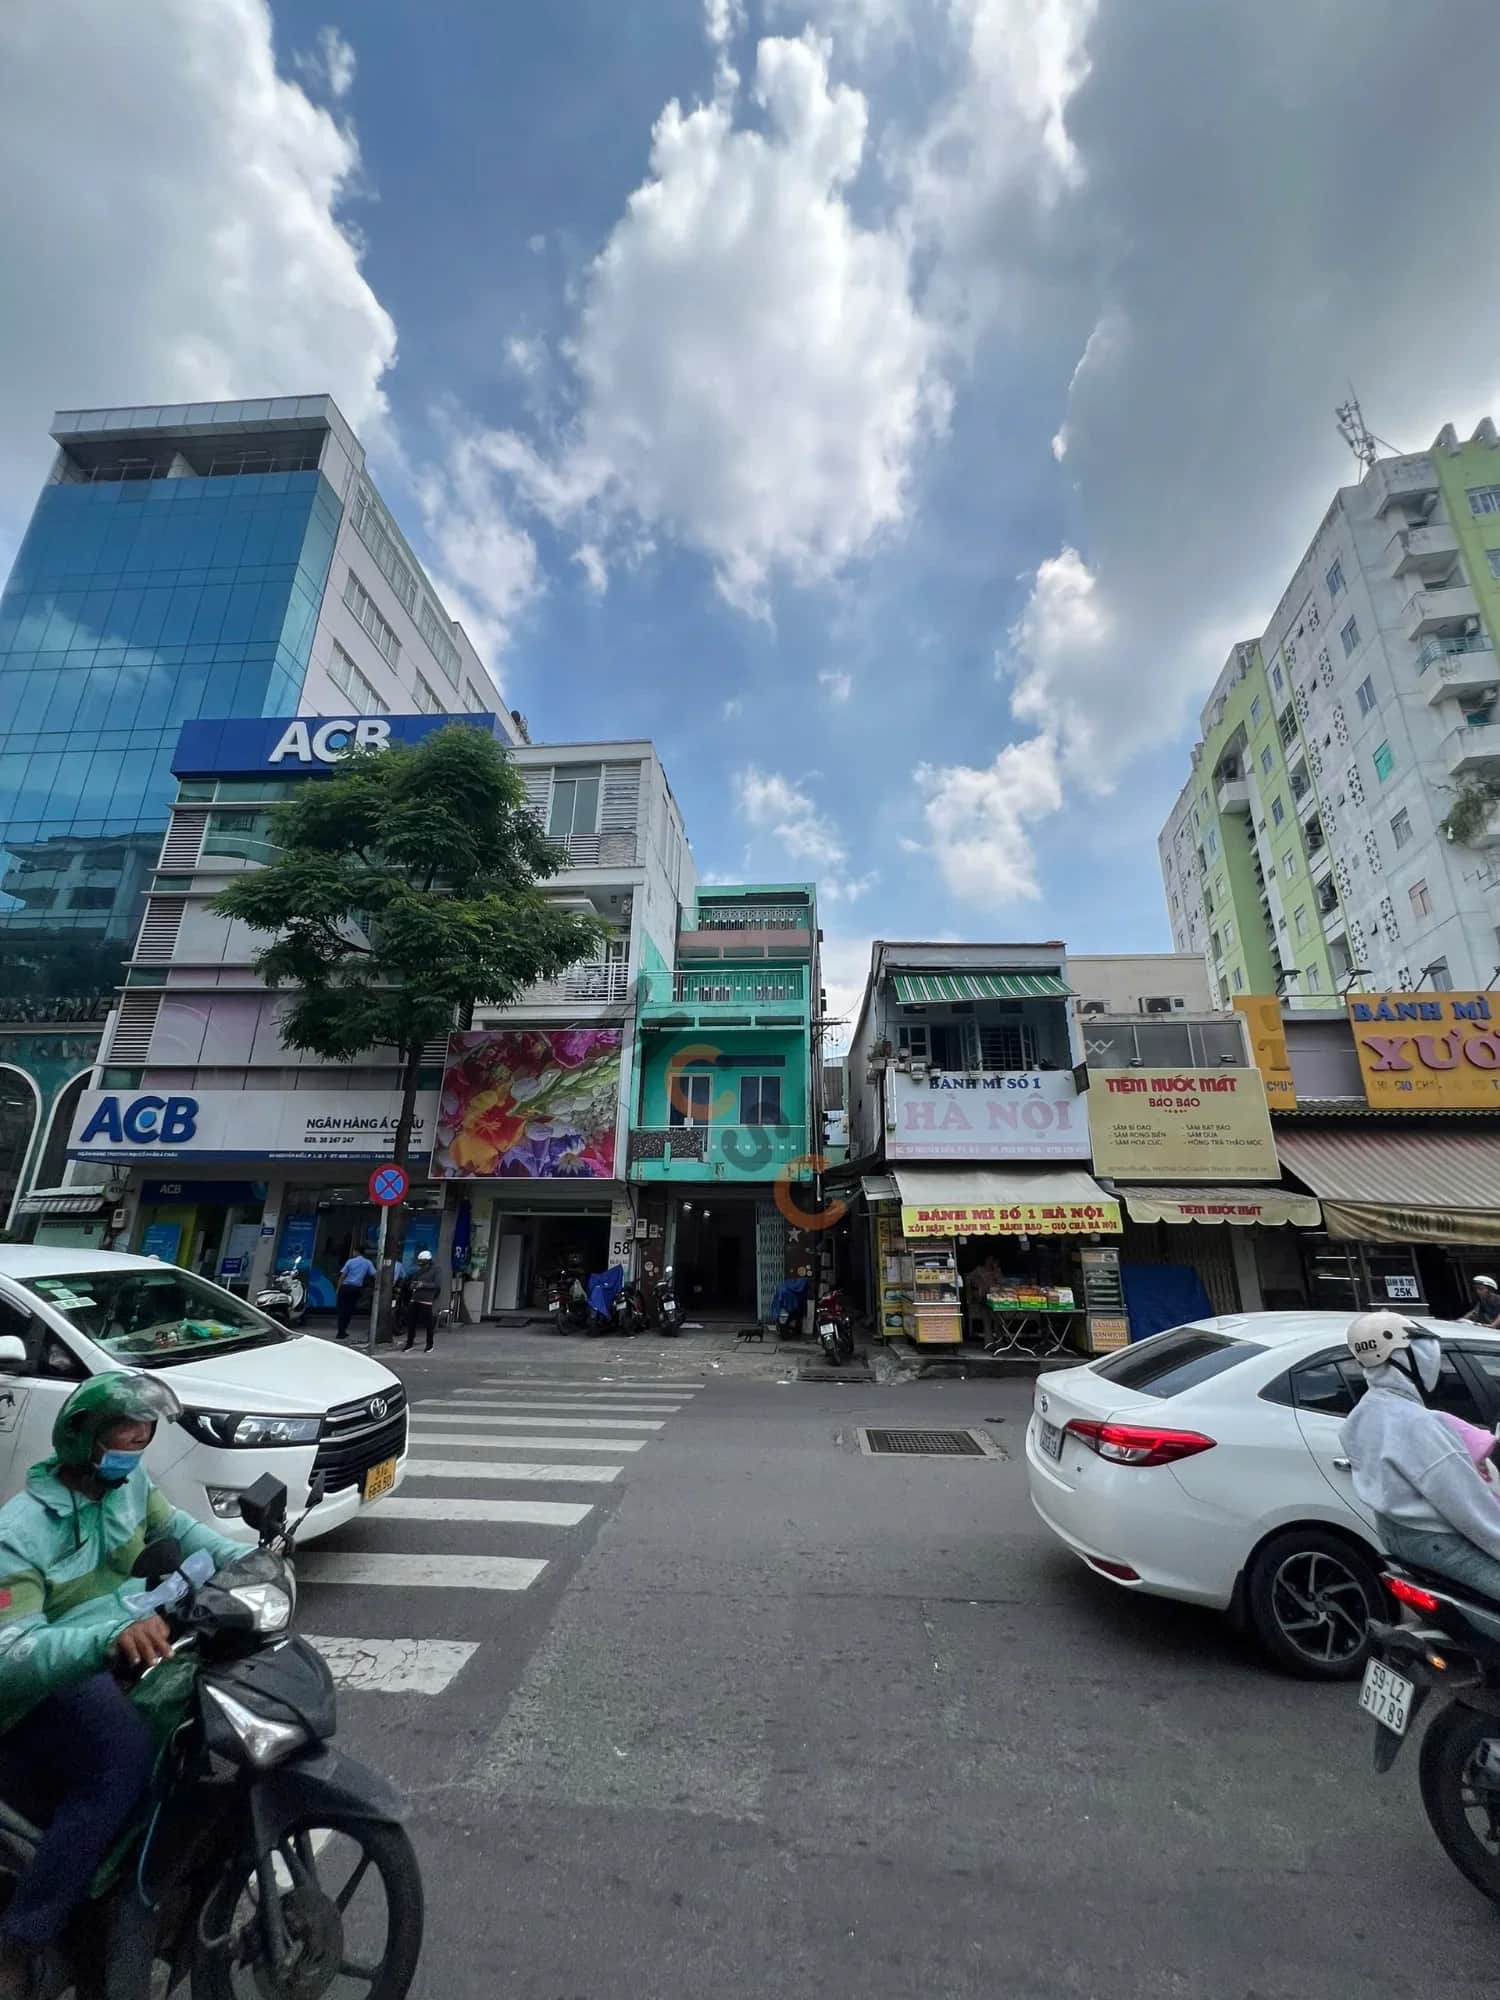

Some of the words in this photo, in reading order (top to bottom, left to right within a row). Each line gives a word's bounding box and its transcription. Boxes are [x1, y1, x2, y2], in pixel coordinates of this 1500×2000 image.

[1351, 995, 1442, 1021] BÁNH
[1451, 995, 1492, 1020] MÌ
[1007, 1073, 1029, 1090] SỐ
[1034, 1077, 1041, 1090] 1
[1199, 1074, 1237, 1093] MÁT
[80, 1096, 199, 1144] ACB
[306, 1117, 341, 1129] NGÂN
[343, 1116, 378, 1129] HÀNG
[379, 1115, 388, 1129] Á
[904, 1093, 972, 1131] HÀ
[985, 1092, 1073, 1139] NỘI
[917, 1208, 967, 1222] BÁNH
[972, 1207, 996, 1221] MÌ
[999, 1205, 1021, 1221] SỐ
[1028, 1208, 1037, 1220] 1
[1042, 1207, 1067, 1220] HÀ
[1070, 1205, 1104, 1221] NỘI
[613, 1241, 630, 1255] 58
[1394, 1287, 1412, 1297] 25K
